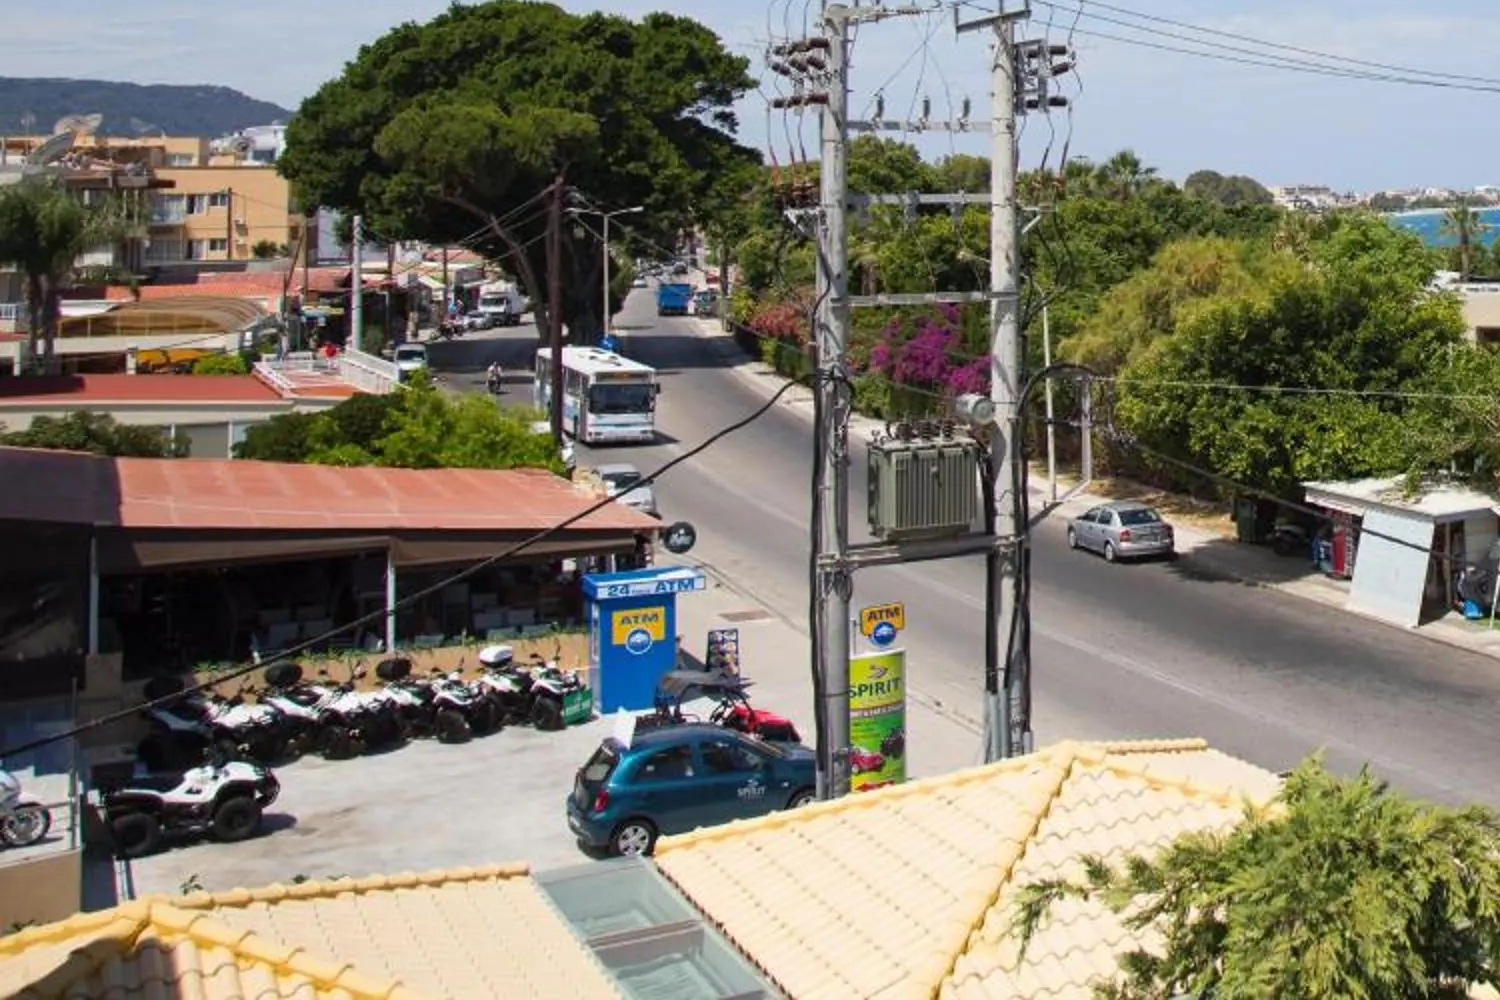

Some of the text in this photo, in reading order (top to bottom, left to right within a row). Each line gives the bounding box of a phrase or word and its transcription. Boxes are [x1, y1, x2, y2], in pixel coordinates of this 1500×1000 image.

[607, 584, 629, 596] 24
[655, 579, 694, 593] ATM
[620, 613, 659, 625] ATM
[867, 606, 900, 622] ATM
[848, 677, 901, 698] SPIRIT
